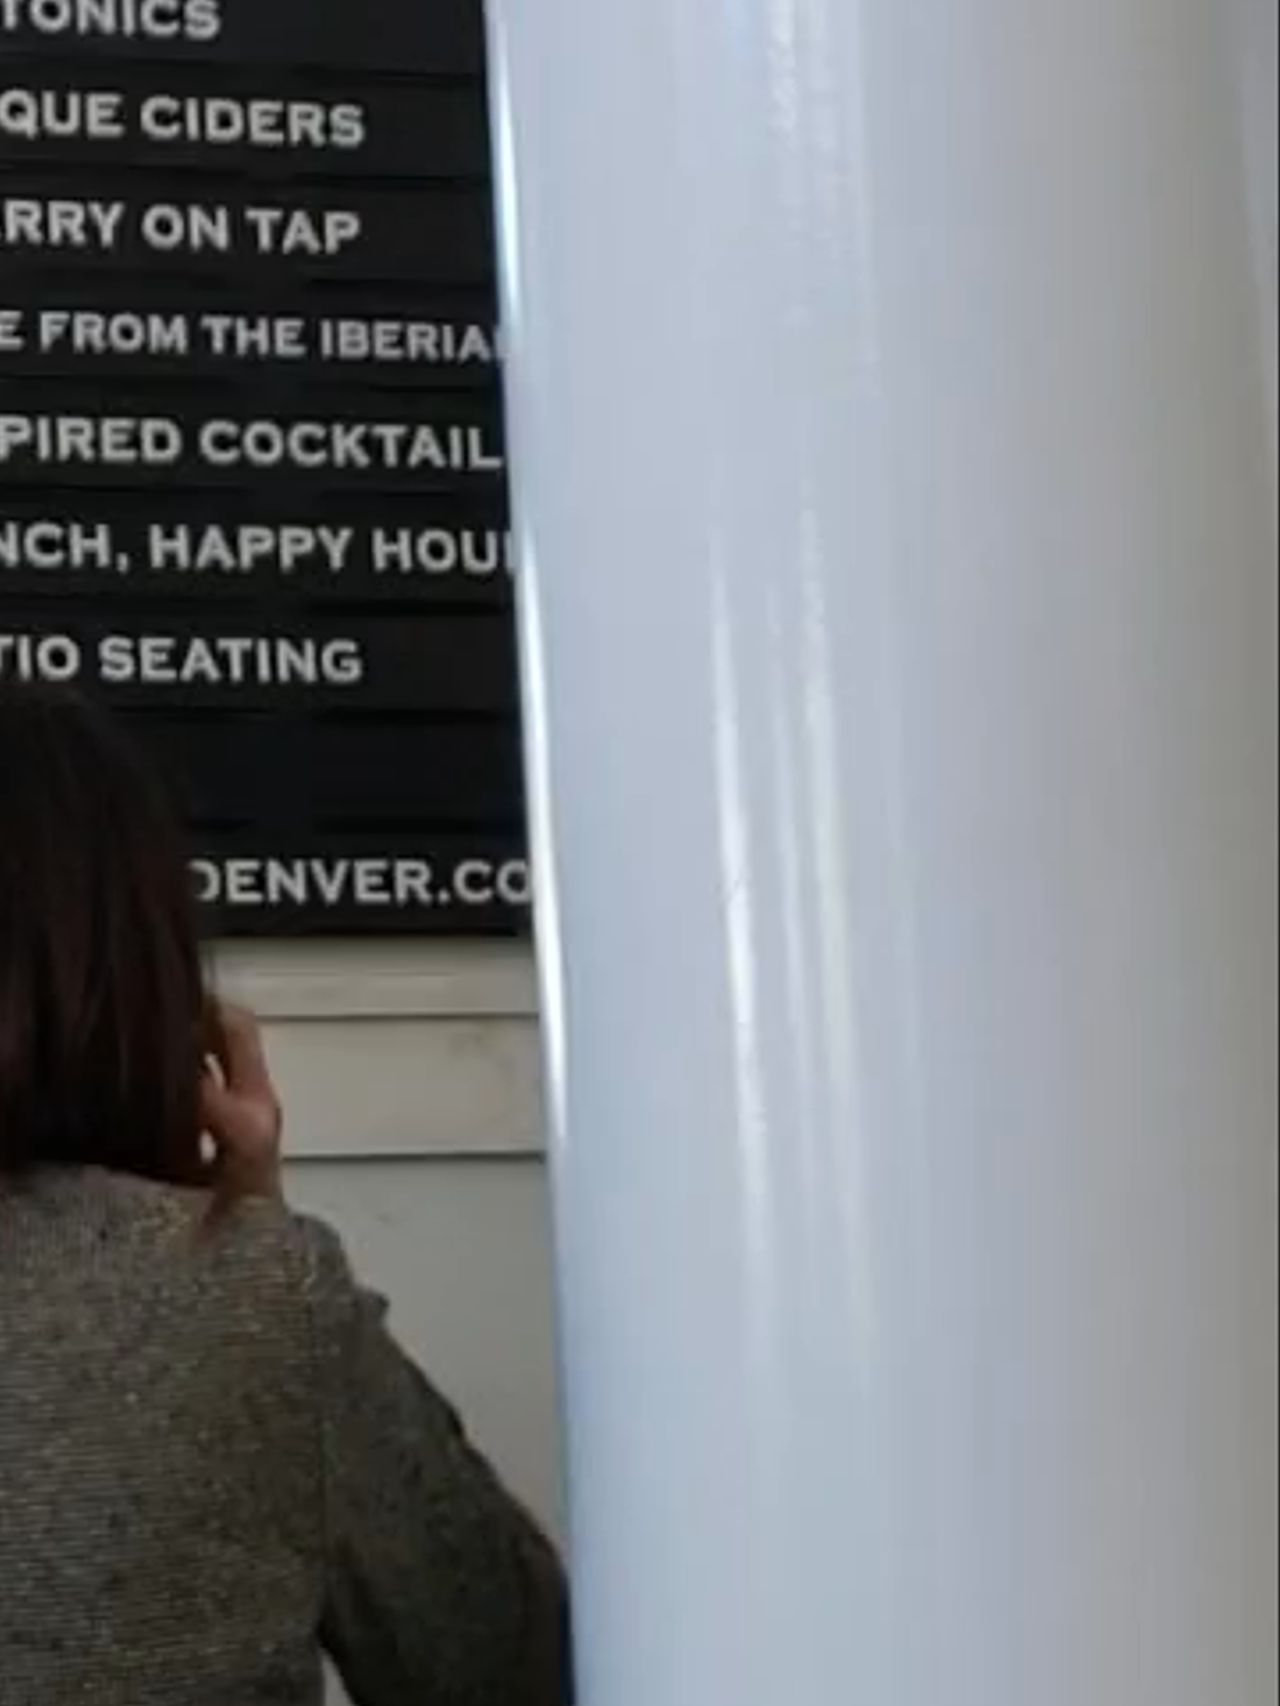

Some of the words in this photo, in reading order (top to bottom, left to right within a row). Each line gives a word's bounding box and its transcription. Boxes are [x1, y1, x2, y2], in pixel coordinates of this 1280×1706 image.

[141, 97, 363, 145] CIDERS
[143, 206, 228, 248] ON
[246, 209, 359, 252] TAP
[41, 312, 187, 352] FROM
[202, 317, 304, 355] THE
[322, 321, 497, 361] IBERIA
[201, 421, 501, 467] COCKTAIL
[151, 525, 351, 568] HAPPY
[100, 637, 360, 681] SEATING
